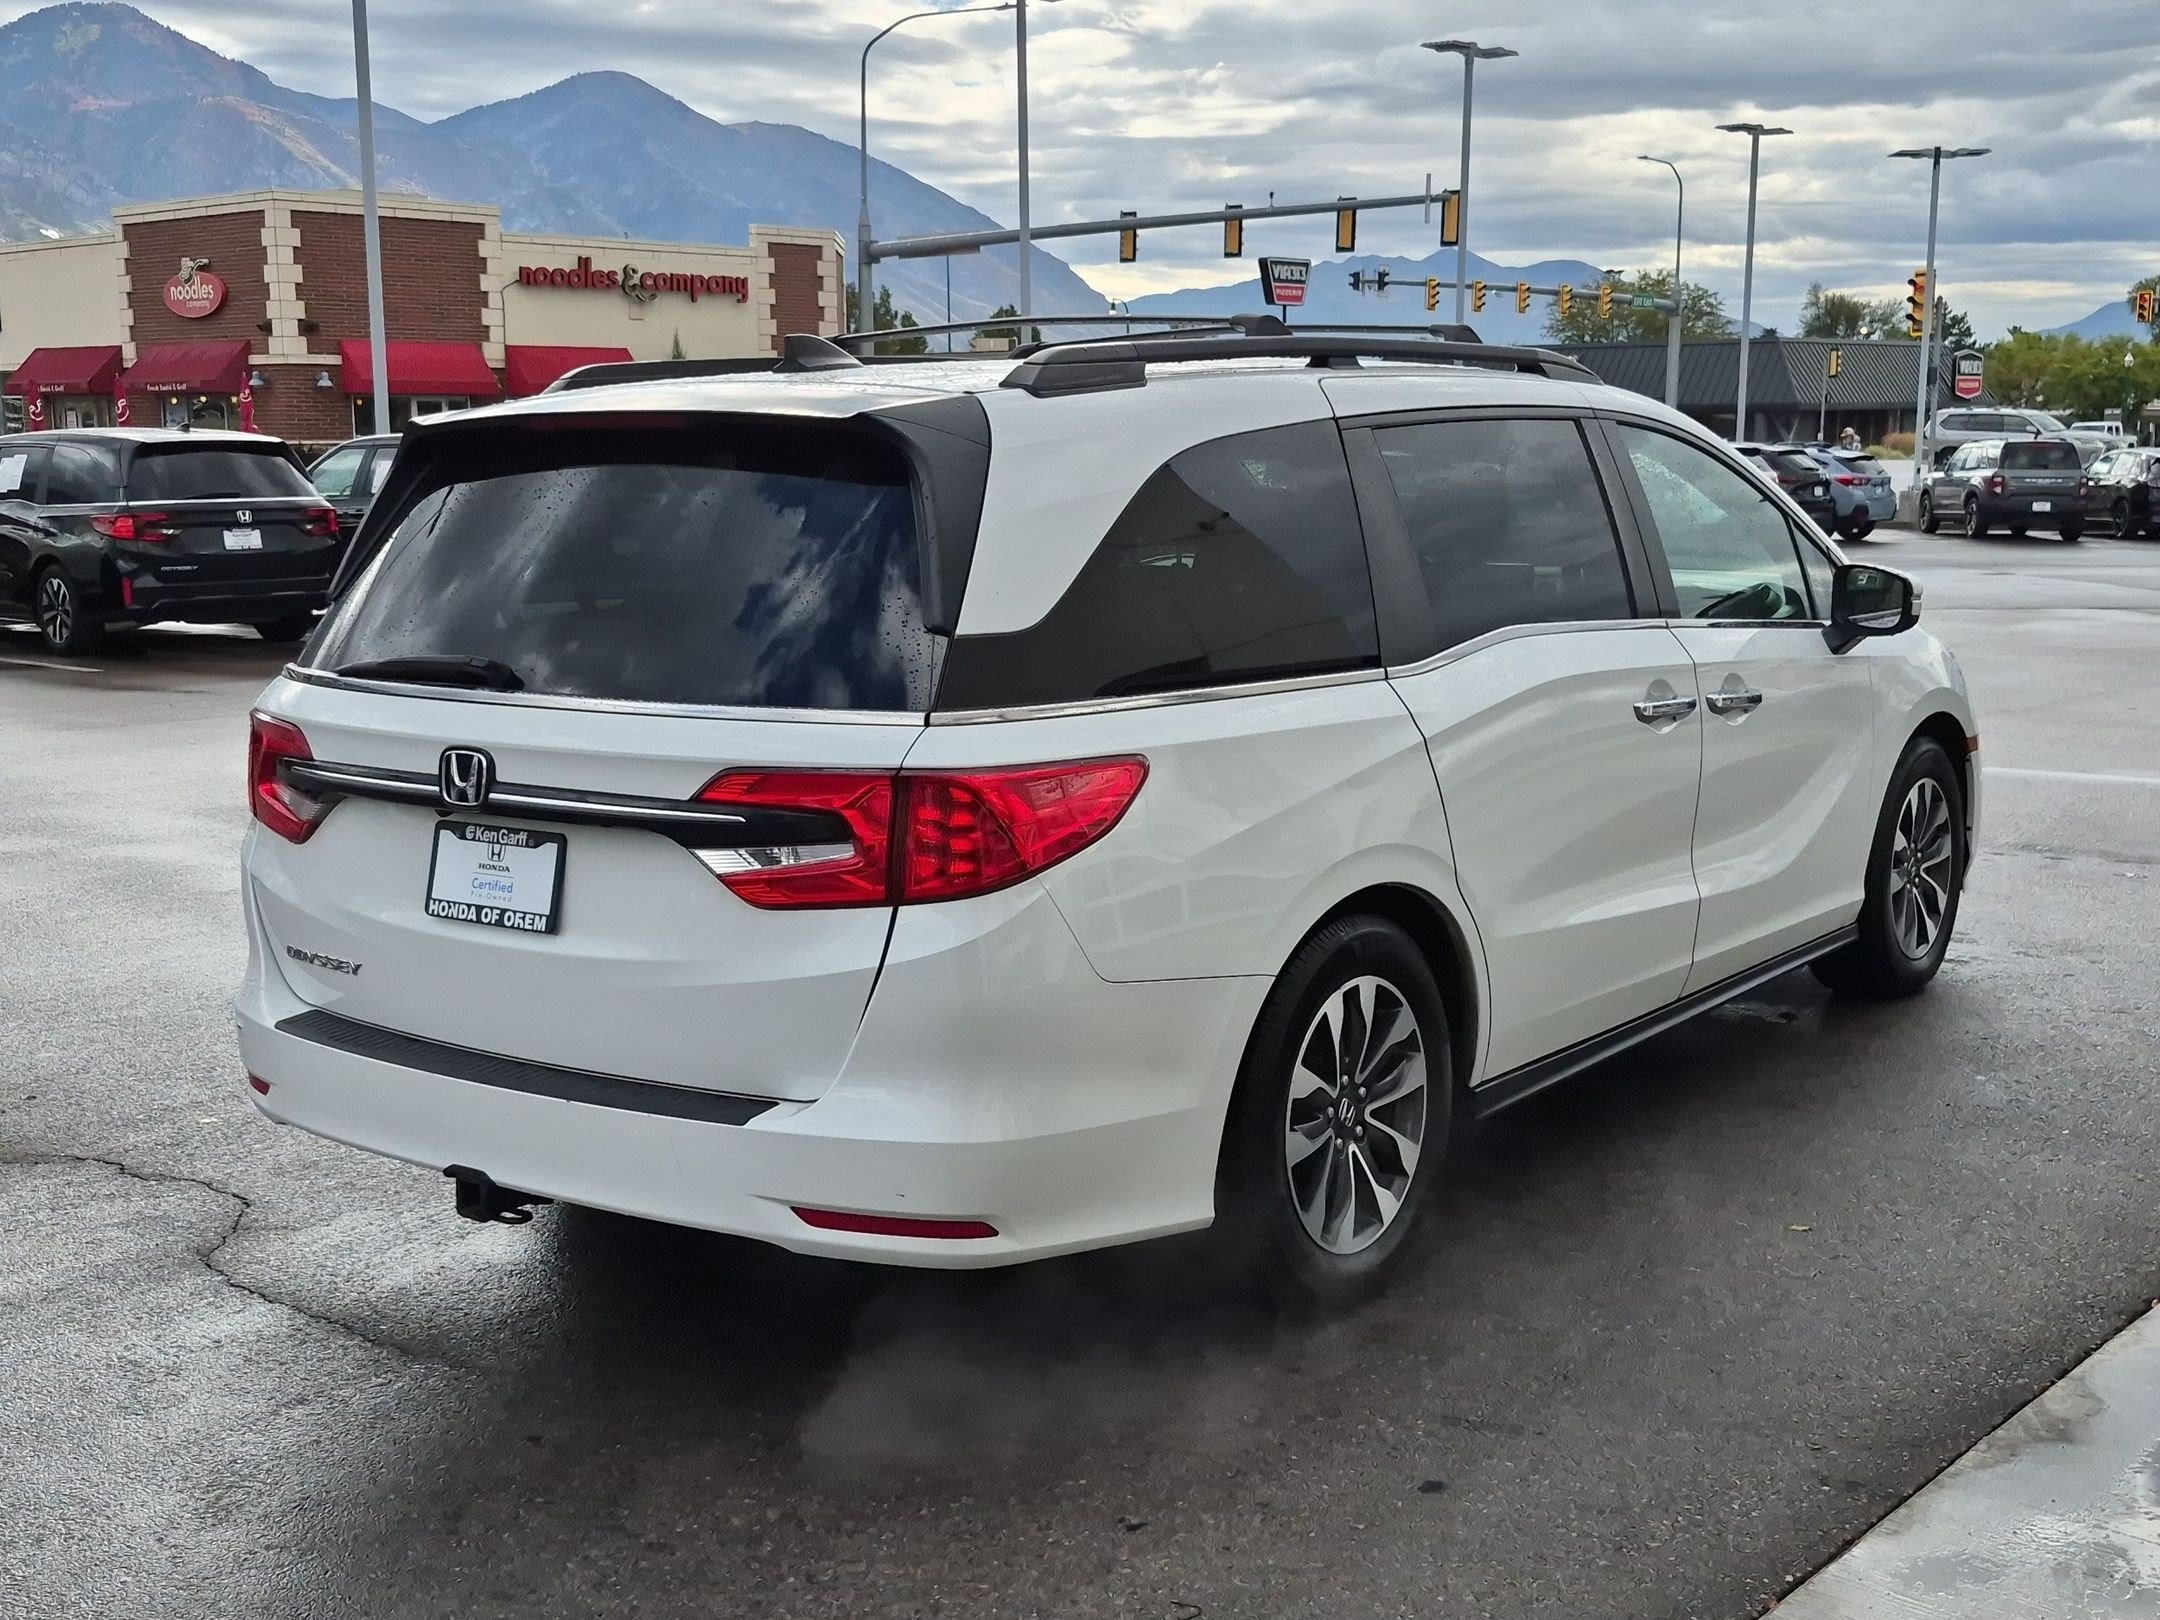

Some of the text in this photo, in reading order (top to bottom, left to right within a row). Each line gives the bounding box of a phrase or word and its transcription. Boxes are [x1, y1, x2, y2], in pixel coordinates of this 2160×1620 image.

[170, 275, 214, 300] noodles
[519, 256, 620, 288] noodles
[640, 272, 748, 303] company
[475, 826, 528, 846] Ken Garff
[478, 862, 511, 873] HONDA
[472, 878, 514, 893] Certified
[428, 899, 547, 932] HONDA OF OREM
[286, 944, 363, 976] ODYSSEY
